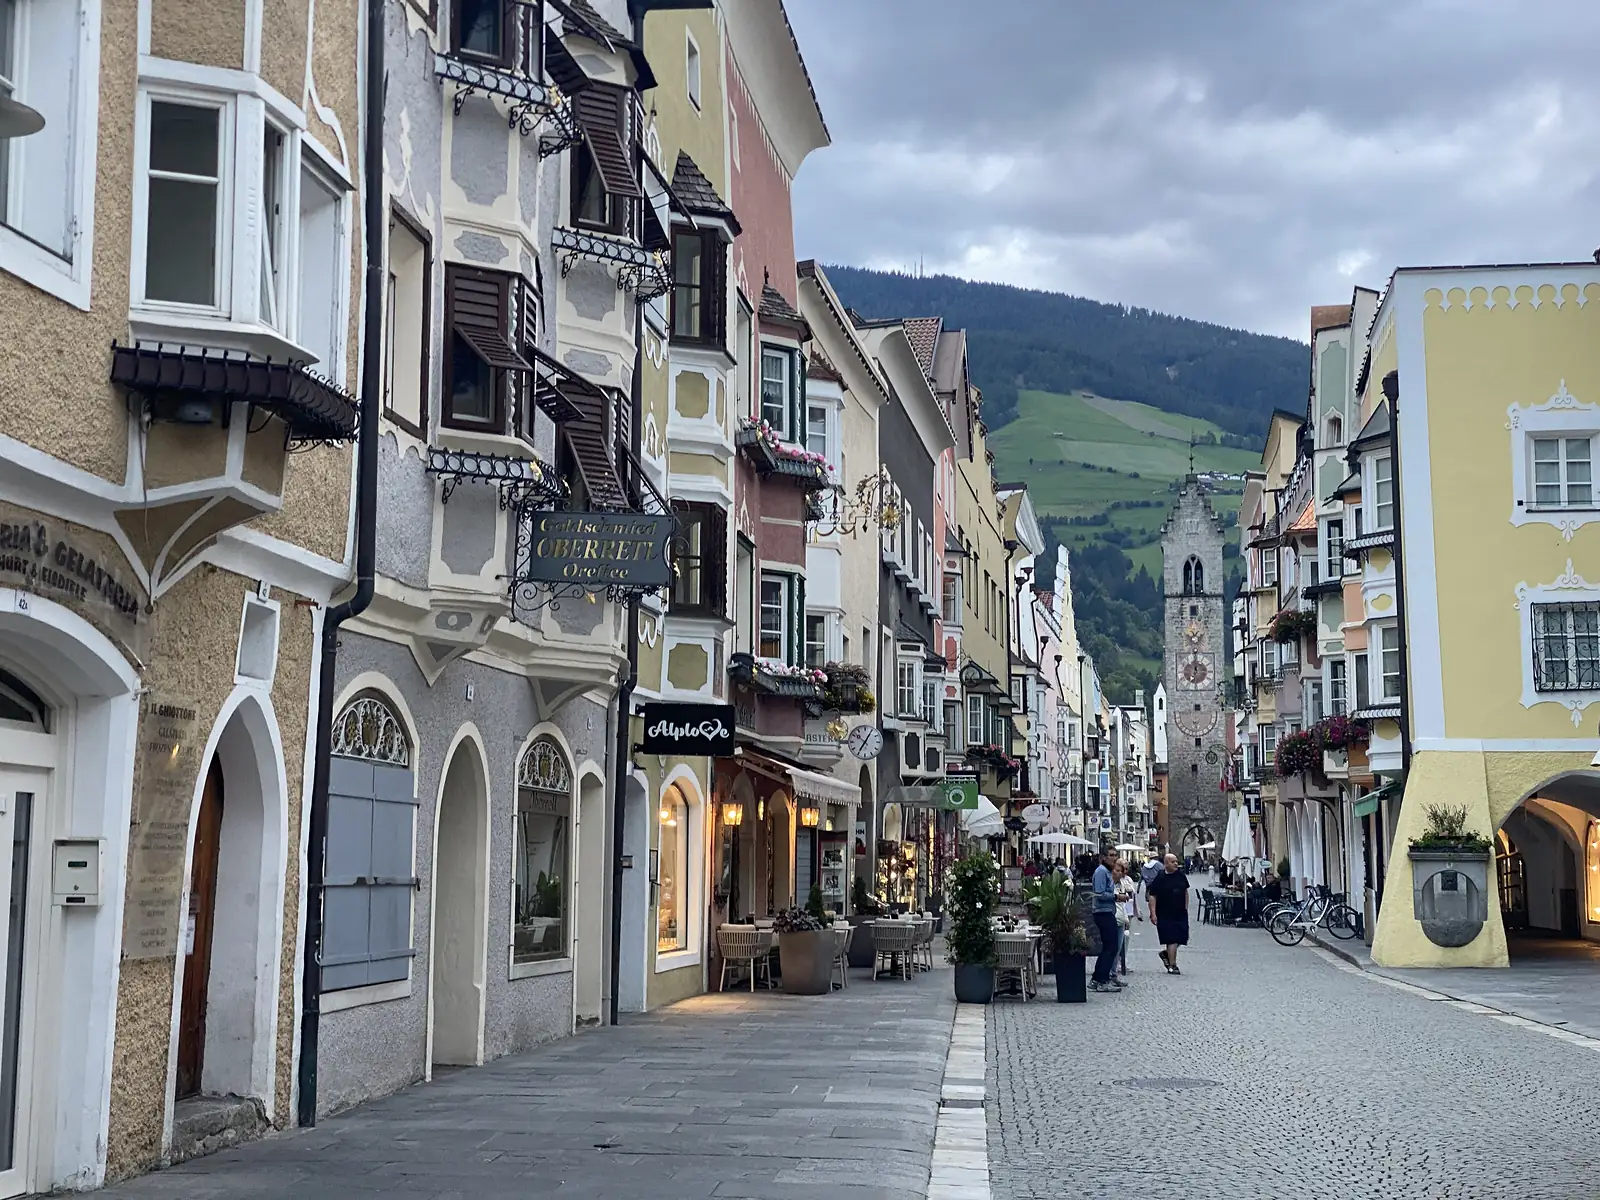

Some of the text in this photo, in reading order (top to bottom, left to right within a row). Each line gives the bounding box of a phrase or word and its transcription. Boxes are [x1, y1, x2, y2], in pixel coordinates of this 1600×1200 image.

[540, 518, 658, 535] Goldschmied
[537, 537, 659, 561] OBERRETL
[563, 562, 629, 579] Orefice
